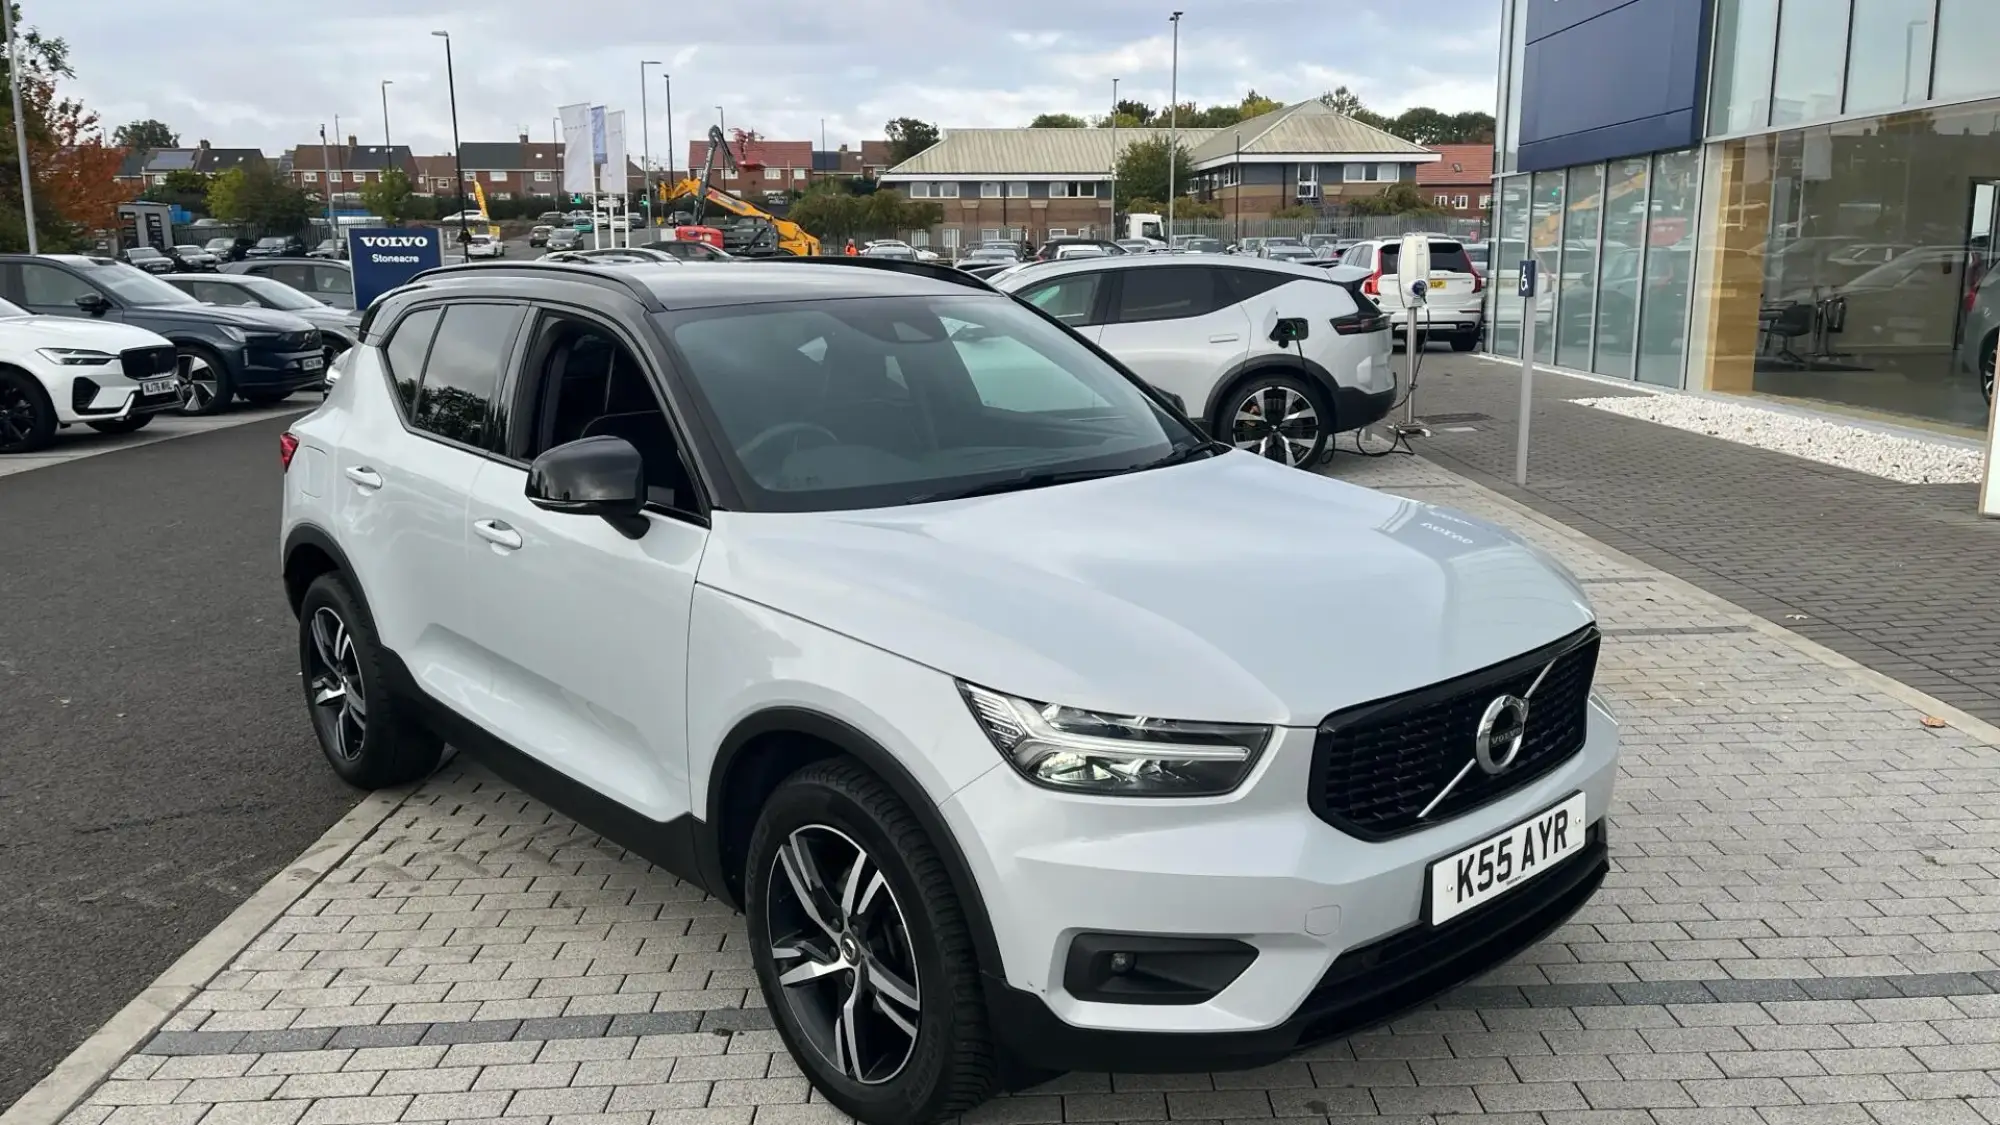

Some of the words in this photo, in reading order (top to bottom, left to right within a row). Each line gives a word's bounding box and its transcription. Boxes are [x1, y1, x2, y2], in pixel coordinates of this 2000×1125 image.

[360, 236, 428, 247] VOLVO
[372, 253, 419, 263] Stoneacre
[1491, 727, 1521, 745] VOLVO
[1457, 836, 1513, 904] K55
[1521, 809, 1568, 872] AYR
